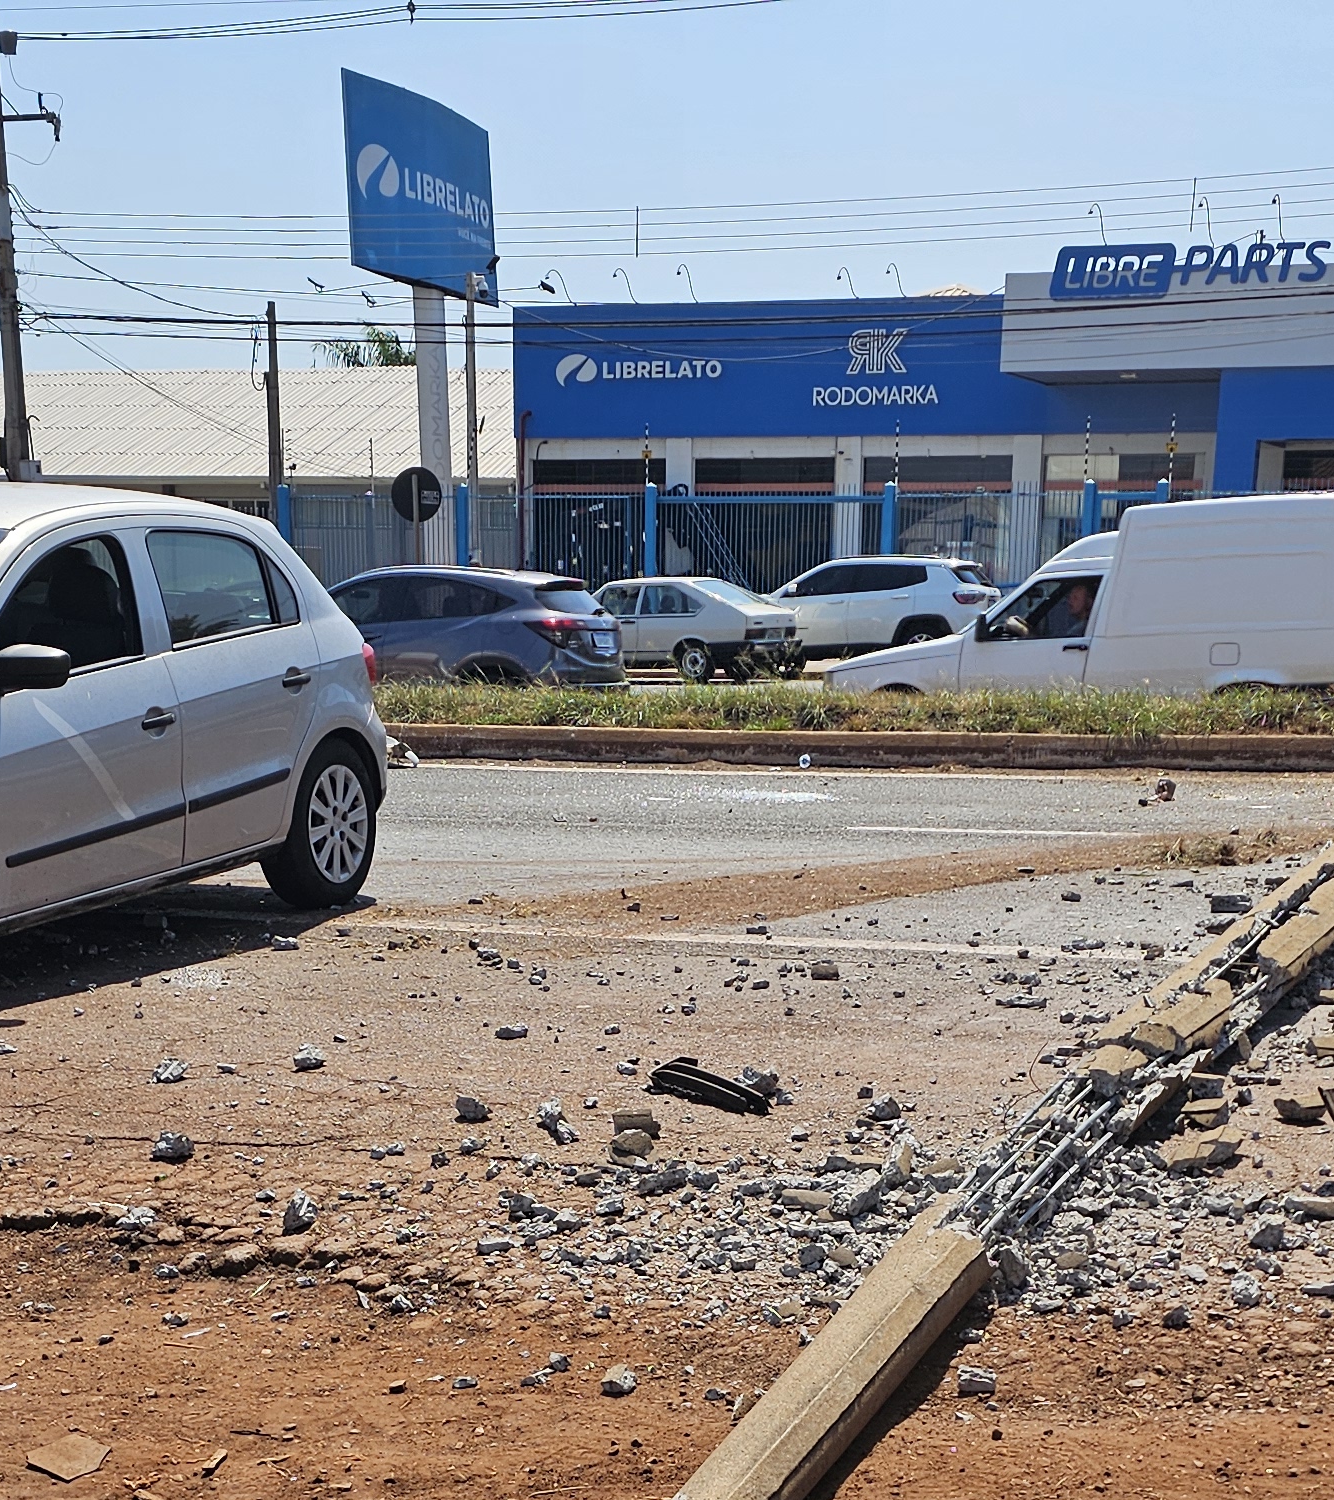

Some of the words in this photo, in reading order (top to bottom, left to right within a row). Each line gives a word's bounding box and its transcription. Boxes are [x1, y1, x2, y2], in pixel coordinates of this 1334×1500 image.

[404, 167, 490, 229] LIBRELATO
[1064, 254, 1164, 289] LIBRE
[1180, 240, 1331, 286] PARTS
[602, 359, 722, 379] LIBRELATO
[812, 384, 939, 406] RODOMARKA
